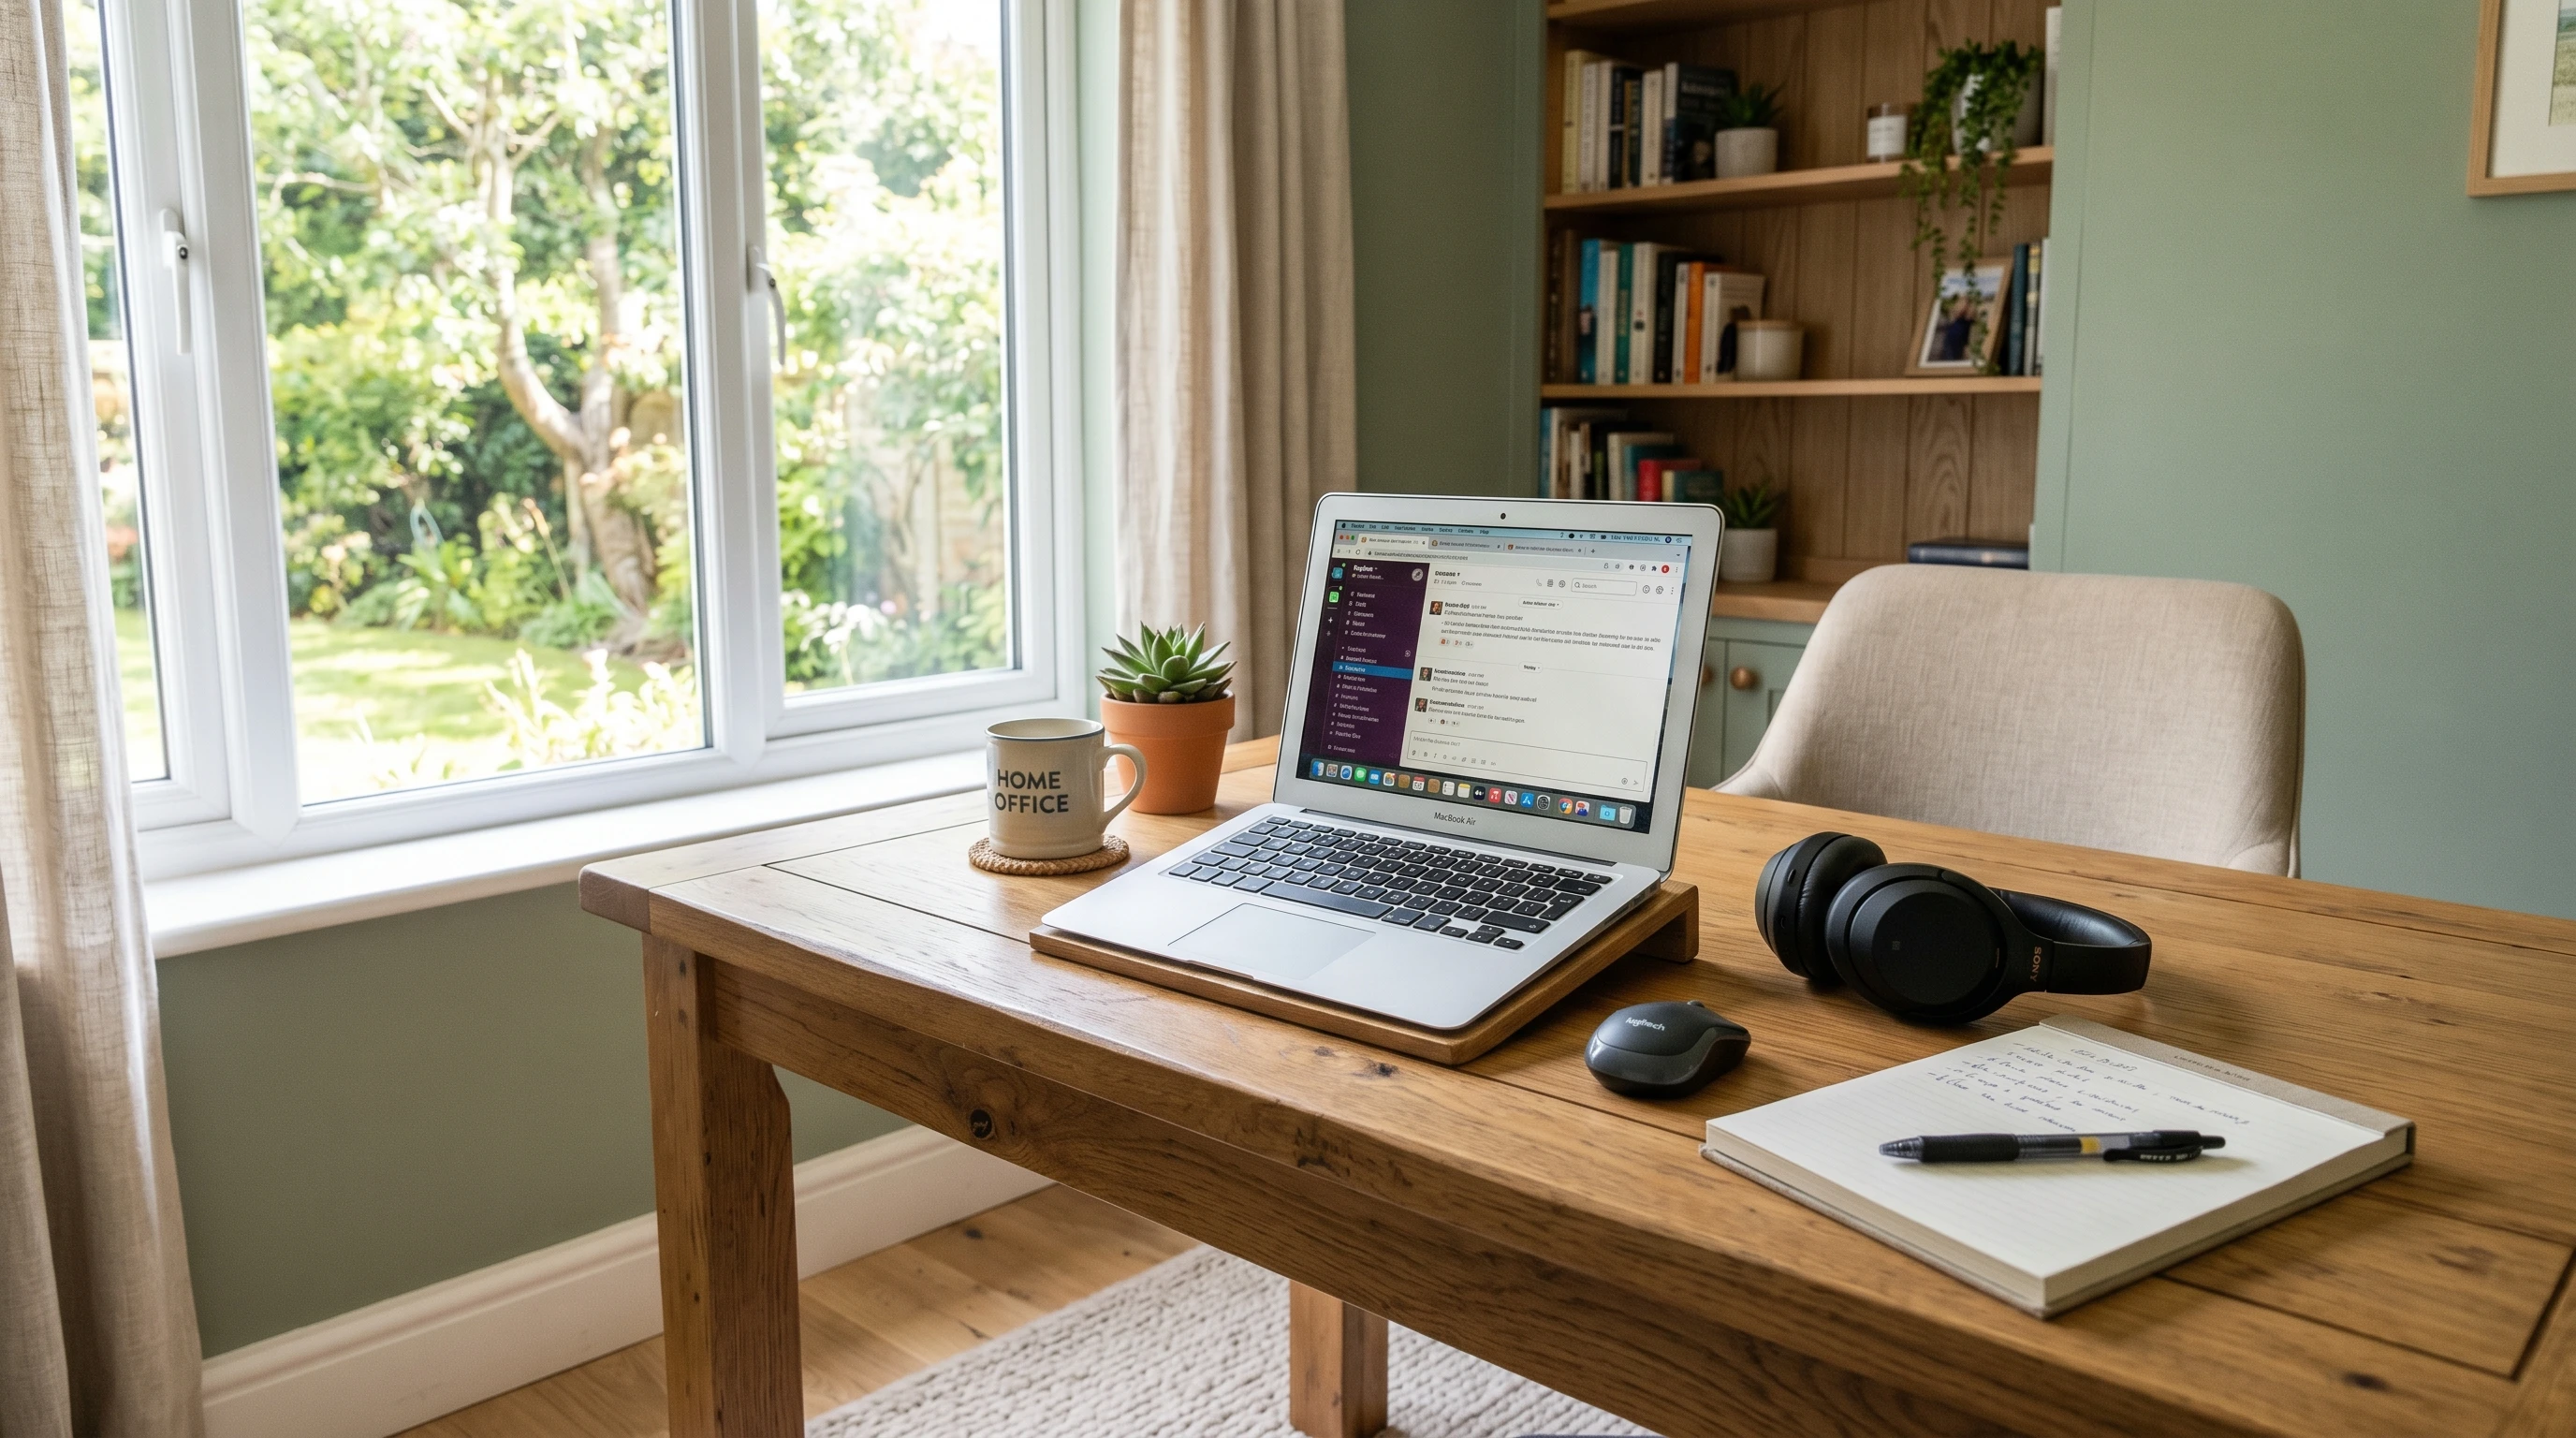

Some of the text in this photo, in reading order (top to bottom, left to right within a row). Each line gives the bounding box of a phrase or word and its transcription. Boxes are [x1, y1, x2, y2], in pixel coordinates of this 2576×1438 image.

[997, 769, 1061, 789] HOME
[994, 792, 1069, 814] OFFICE
[1433, 812, 1476, 826] MacBook Air
[2029, 946, 2042, 982] SONY
